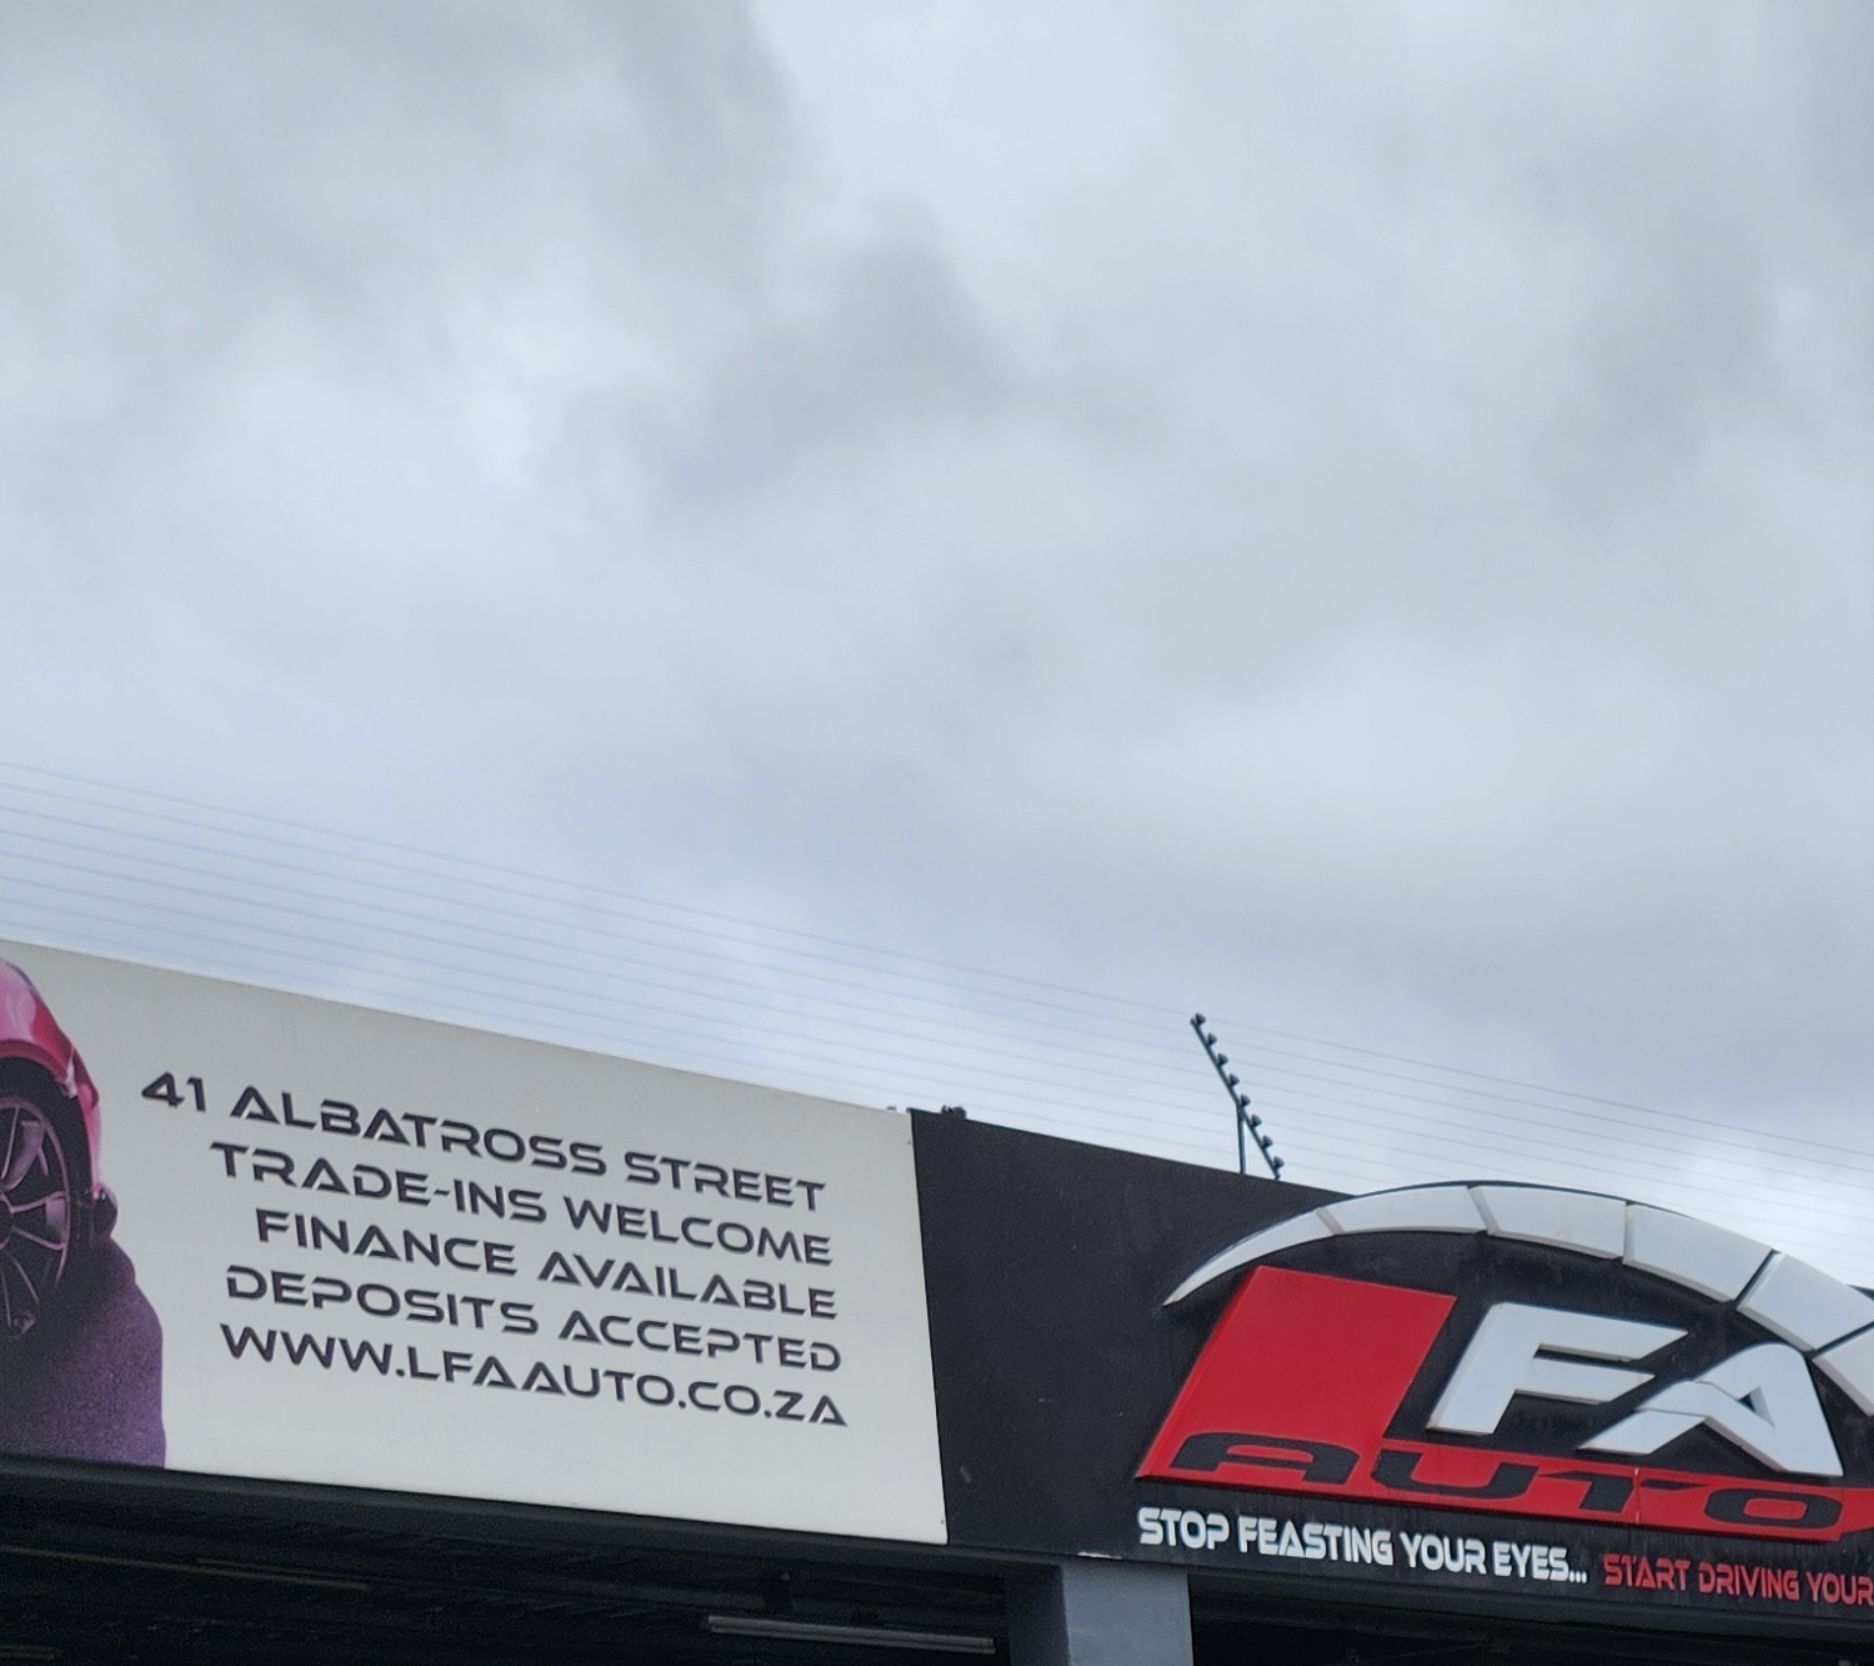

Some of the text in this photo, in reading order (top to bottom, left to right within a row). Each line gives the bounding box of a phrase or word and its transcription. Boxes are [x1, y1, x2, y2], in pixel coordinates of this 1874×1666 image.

[141, 1072, 826, 1212] 41 ALBATROSS STREET
[209, 1143, 831, 1267] TRADE-INS WELCOME
[227, 1265, 842, 1372] DEPOSITS ACCEPTED
[256, 1210, 838, 1320] FINANCE AVAILABLE
[220, 1323, 848, 1426] WWW.LFAAUTO.CO.ZA
[1170, 1433, 1842, 1528] AUTO
[1138, 1507, 1230, 1549] STOP
[1239, 1516, 1395, 1566] FEASTING
[1401, 1531, 1488, 1574] YOUR
[1492, 1541, 1588, 1584] EYES...
[1604, 1553, 1691, 1591] START
[1698, 1561, 1799, 1602] DRIVING
[1805, 1572, 1874, 1608] YOUR
